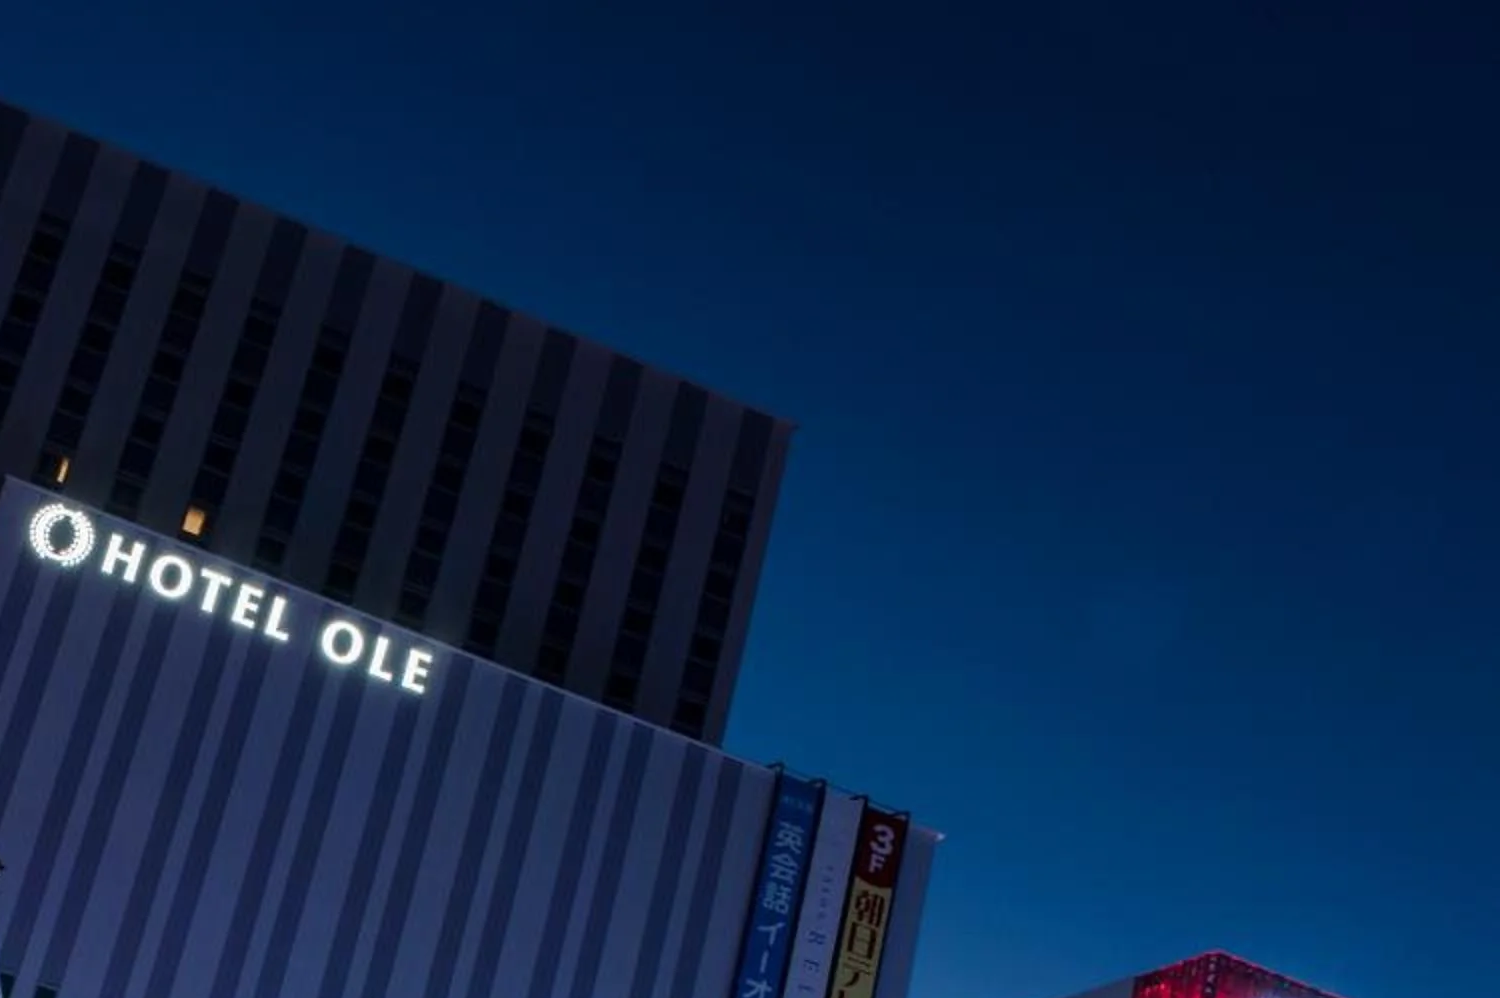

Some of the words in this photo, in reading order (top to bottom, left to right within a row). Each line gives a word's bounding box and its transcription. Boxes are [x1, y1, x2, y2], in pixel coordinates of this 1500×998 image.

[101, 532, 290, 642] HOTEL
[321, 619, 435, 695] OLE
[868, 823, 896, 874] 3F
